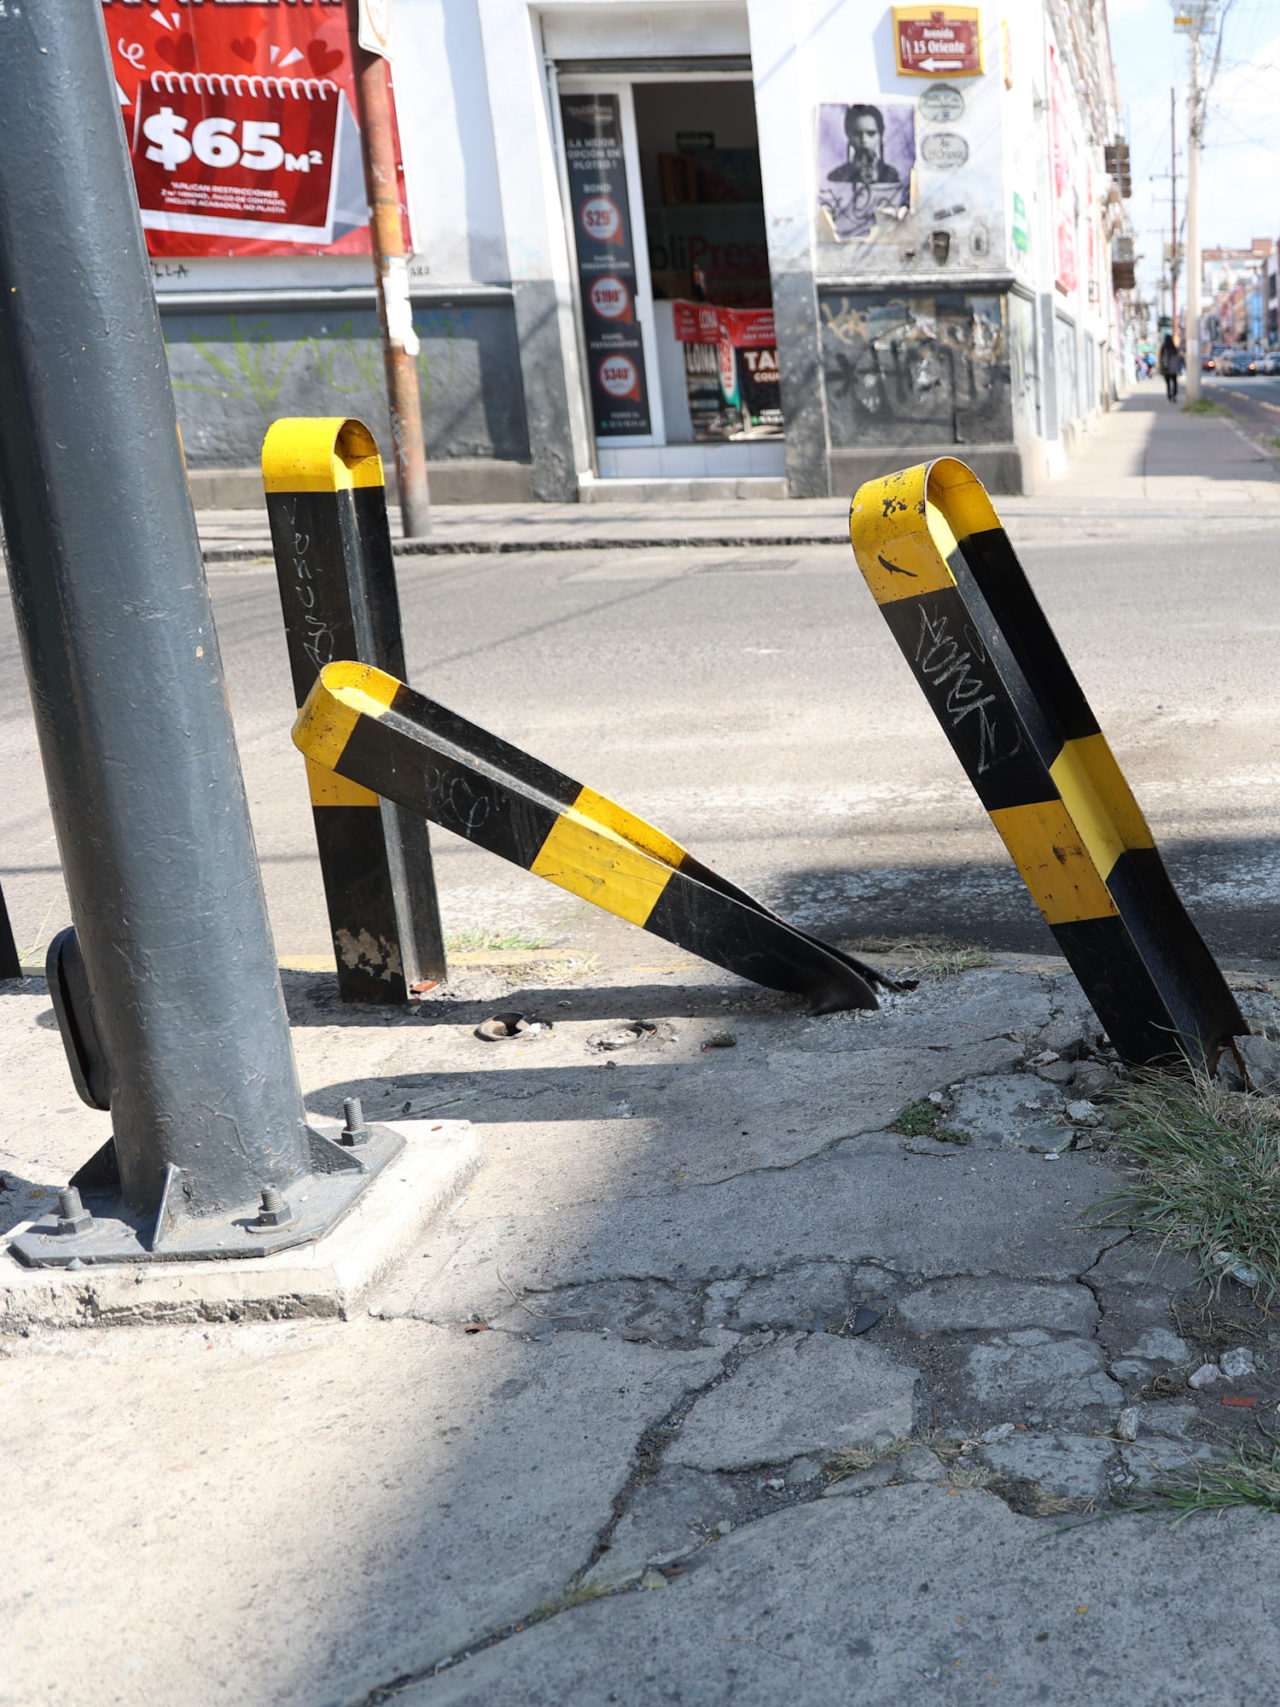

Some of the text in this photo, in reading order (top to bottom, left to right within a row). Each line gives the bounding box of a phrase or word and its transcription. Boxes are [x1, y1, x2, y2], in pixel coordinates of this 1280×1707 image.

[923, 28, 955, 40] Avenida
[914, 40, 966, 54] 15 Oriente
